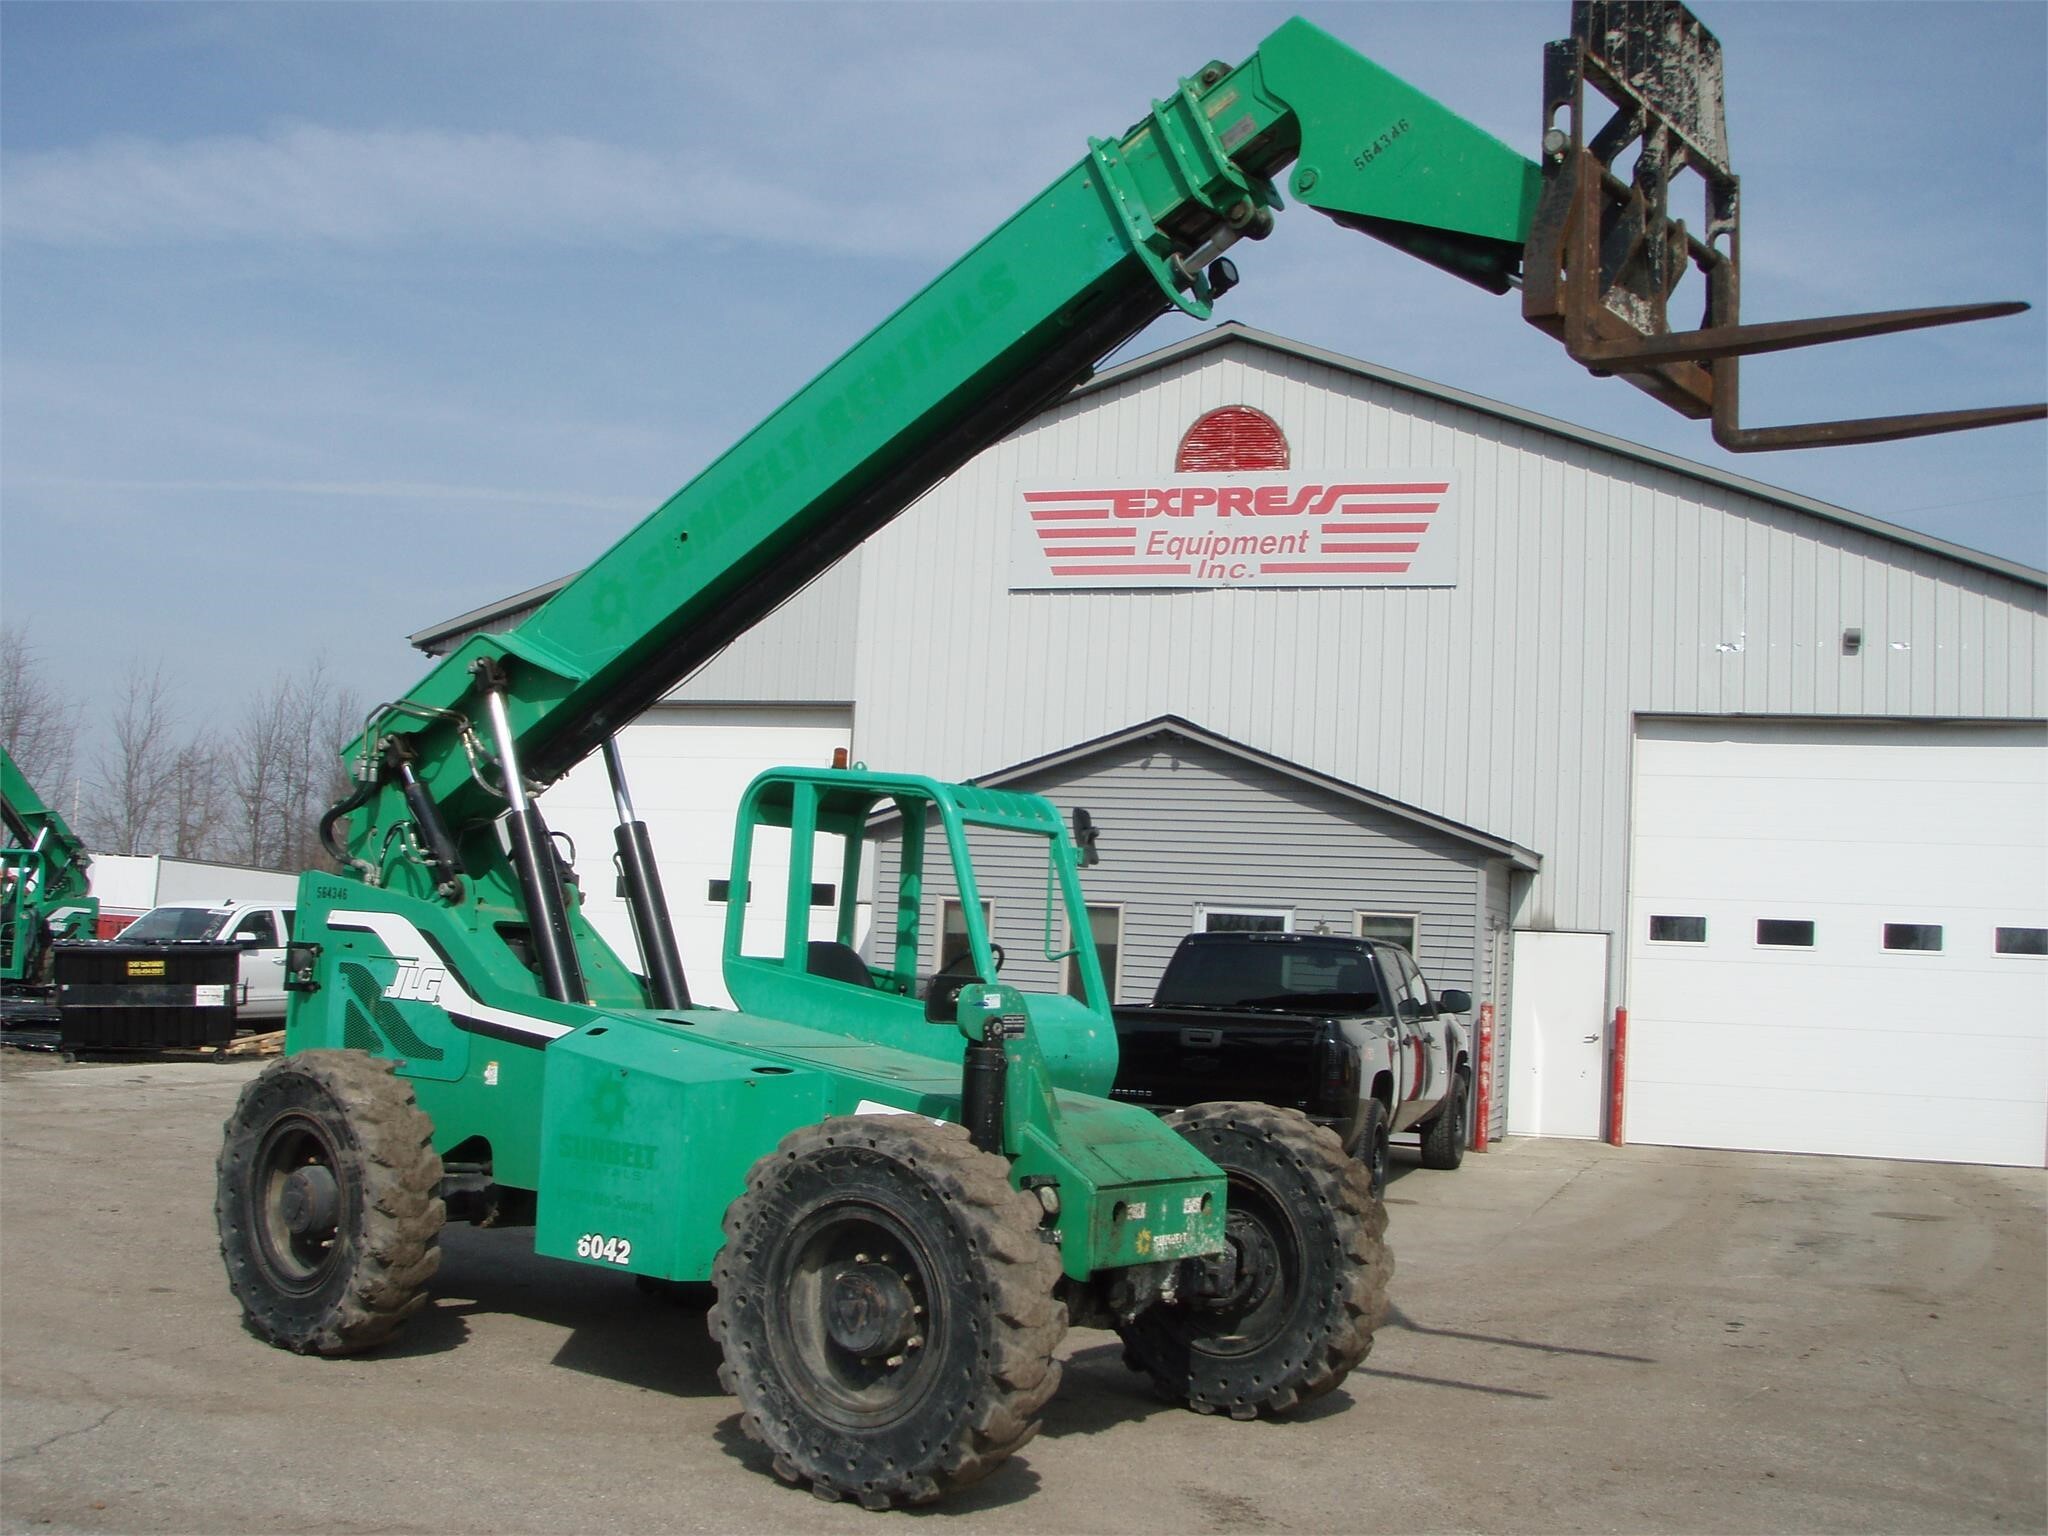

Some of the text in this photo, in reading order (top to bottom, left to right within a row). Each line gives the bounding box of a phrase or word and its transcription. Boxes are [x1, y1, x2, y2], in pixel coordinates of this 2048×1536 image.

[1354, 118, 1409, 171] 564346
[1113, 484, 1345, 518] EXPRESS
[1146, 530, 1309, 560] Equipment
[1197, 559, 1255, 579] Inc.
[317, 886, 348, 900] 564346
[384, 965, 446, 1003] JLG
[577, 1234, 631, 1265] 6042
